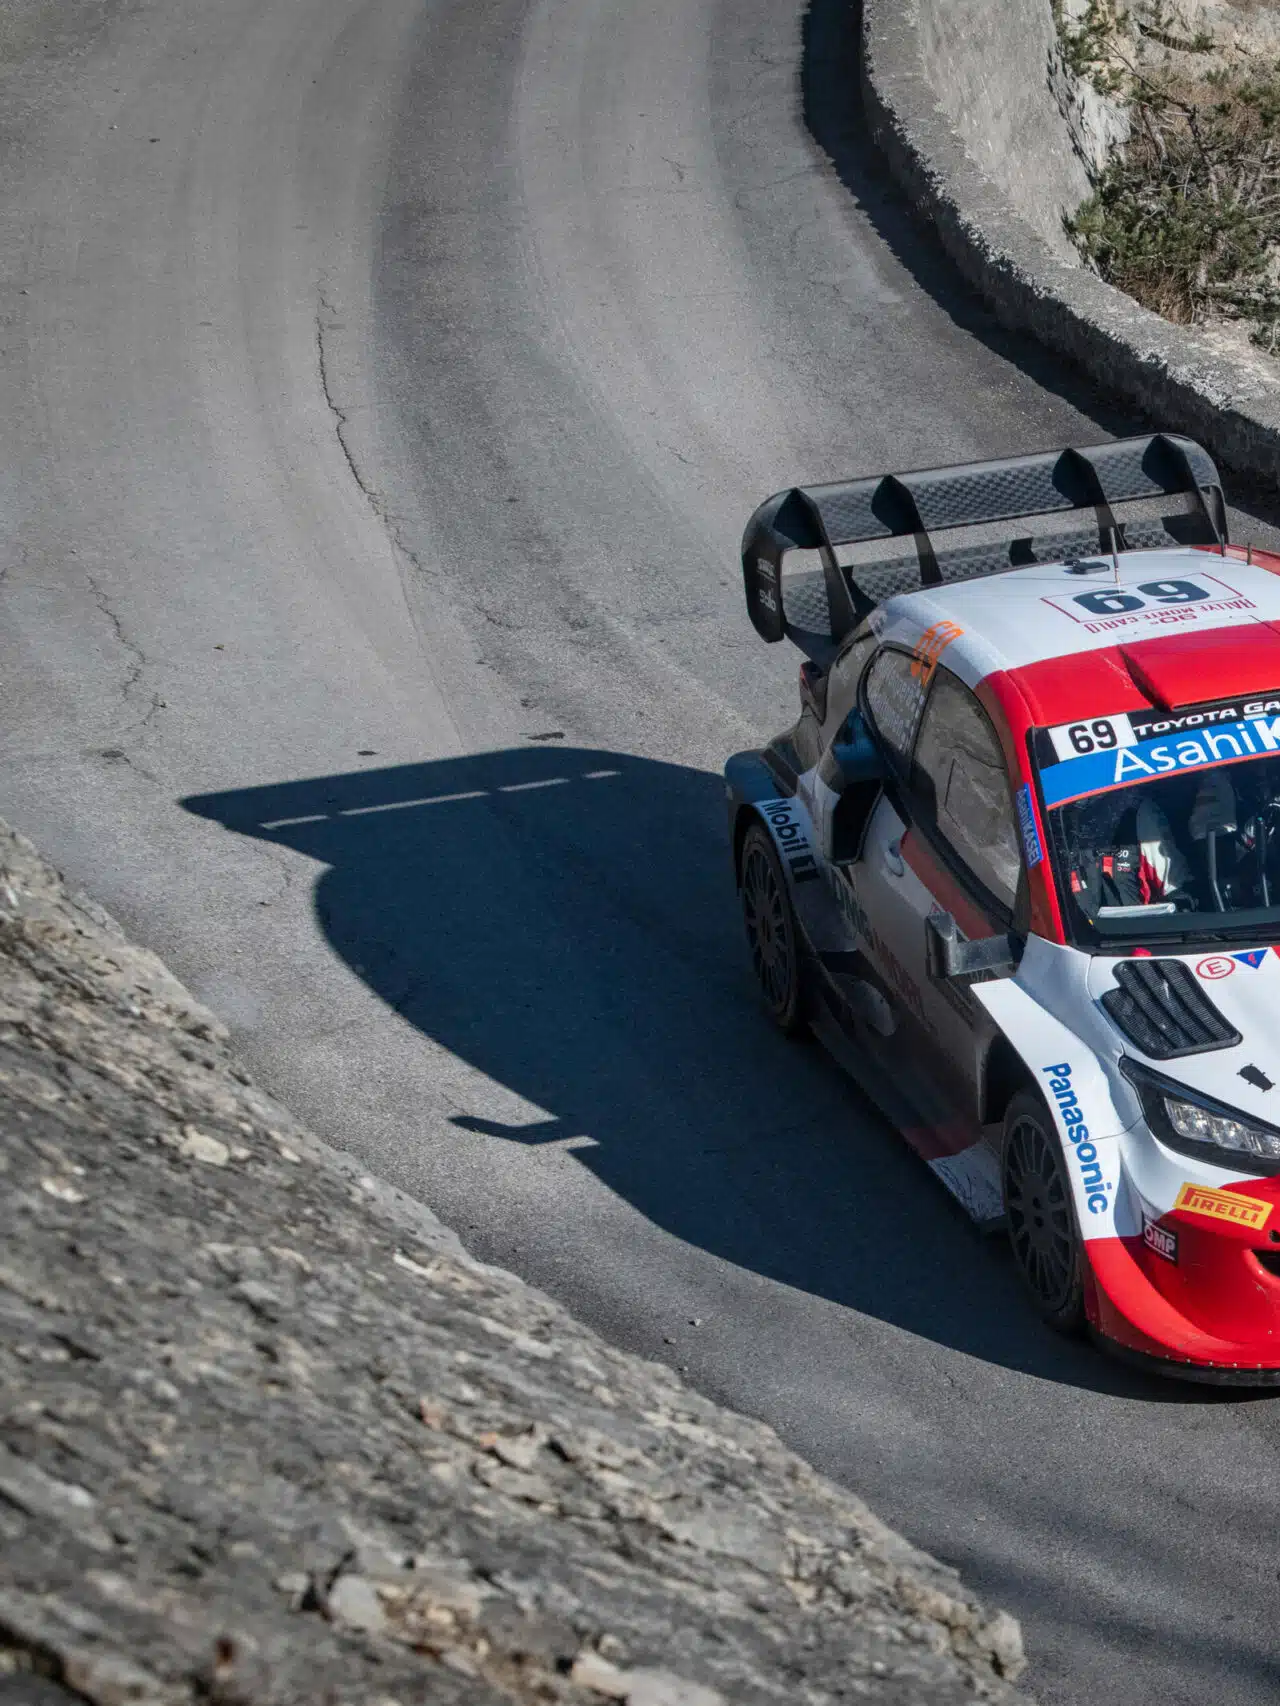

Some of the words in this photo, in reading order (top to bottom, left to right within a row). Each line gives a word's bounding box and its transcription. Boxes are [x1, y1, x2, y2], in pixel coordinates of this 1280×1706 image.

[1072, 580, 1211, 615] 69
[1199, 598, 1258, 613] RALLYE
[1067, 719, 1118, 754] 69
[1132, 707, 1238, 737] TOYOTA
[761, 800, 811, 853] Mobil
[1041, 1062, 1113, 1215] Panasonic
[1181, 1187, 1264, 1224] PIRELLI
[1143, 1223, 1176, 1254] OMP
